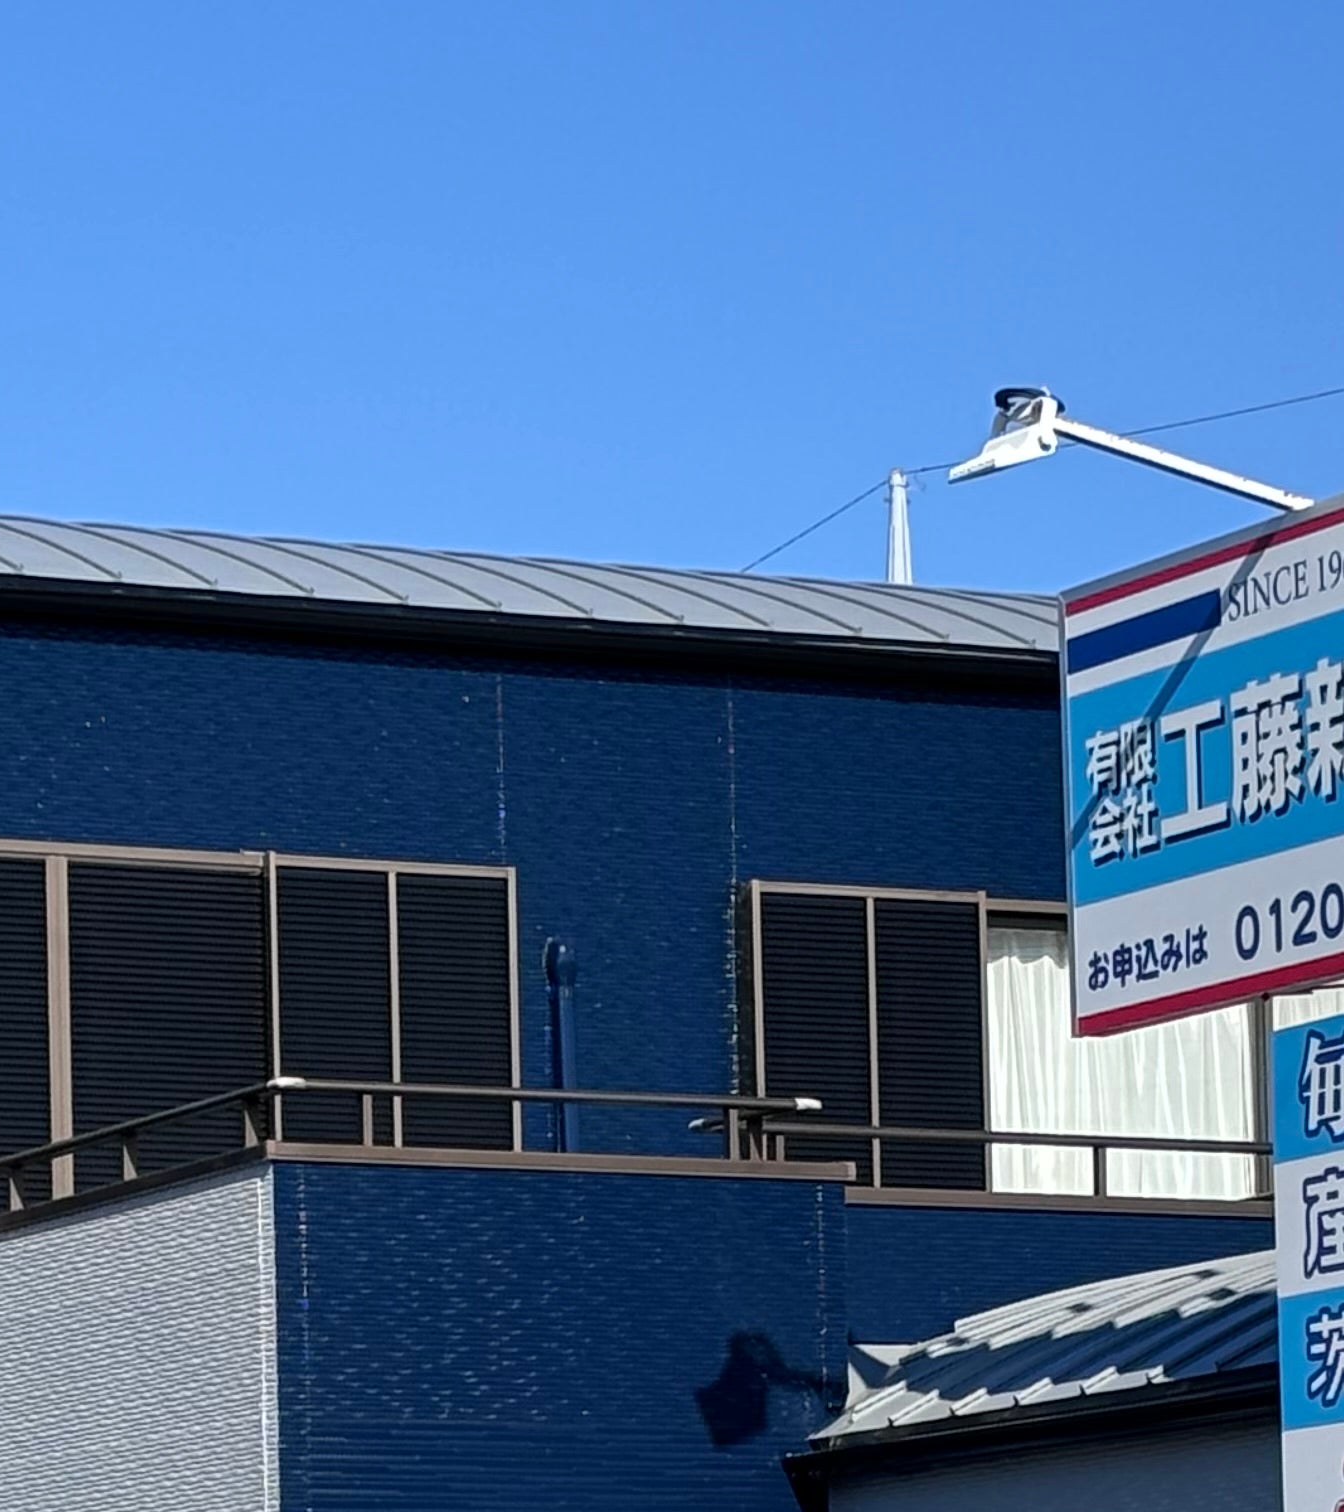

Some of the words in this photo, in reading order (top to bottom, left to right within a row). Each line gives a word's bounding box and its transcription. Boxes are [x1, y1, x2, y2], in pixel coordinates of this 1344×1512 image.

[1226, 566, 1311, 622] SINCE
[1084, 716, 1159, 800] 有限
[1088, 784, 1161, 866] 会社
[1087, 926, 1209, 992] お申込みは
